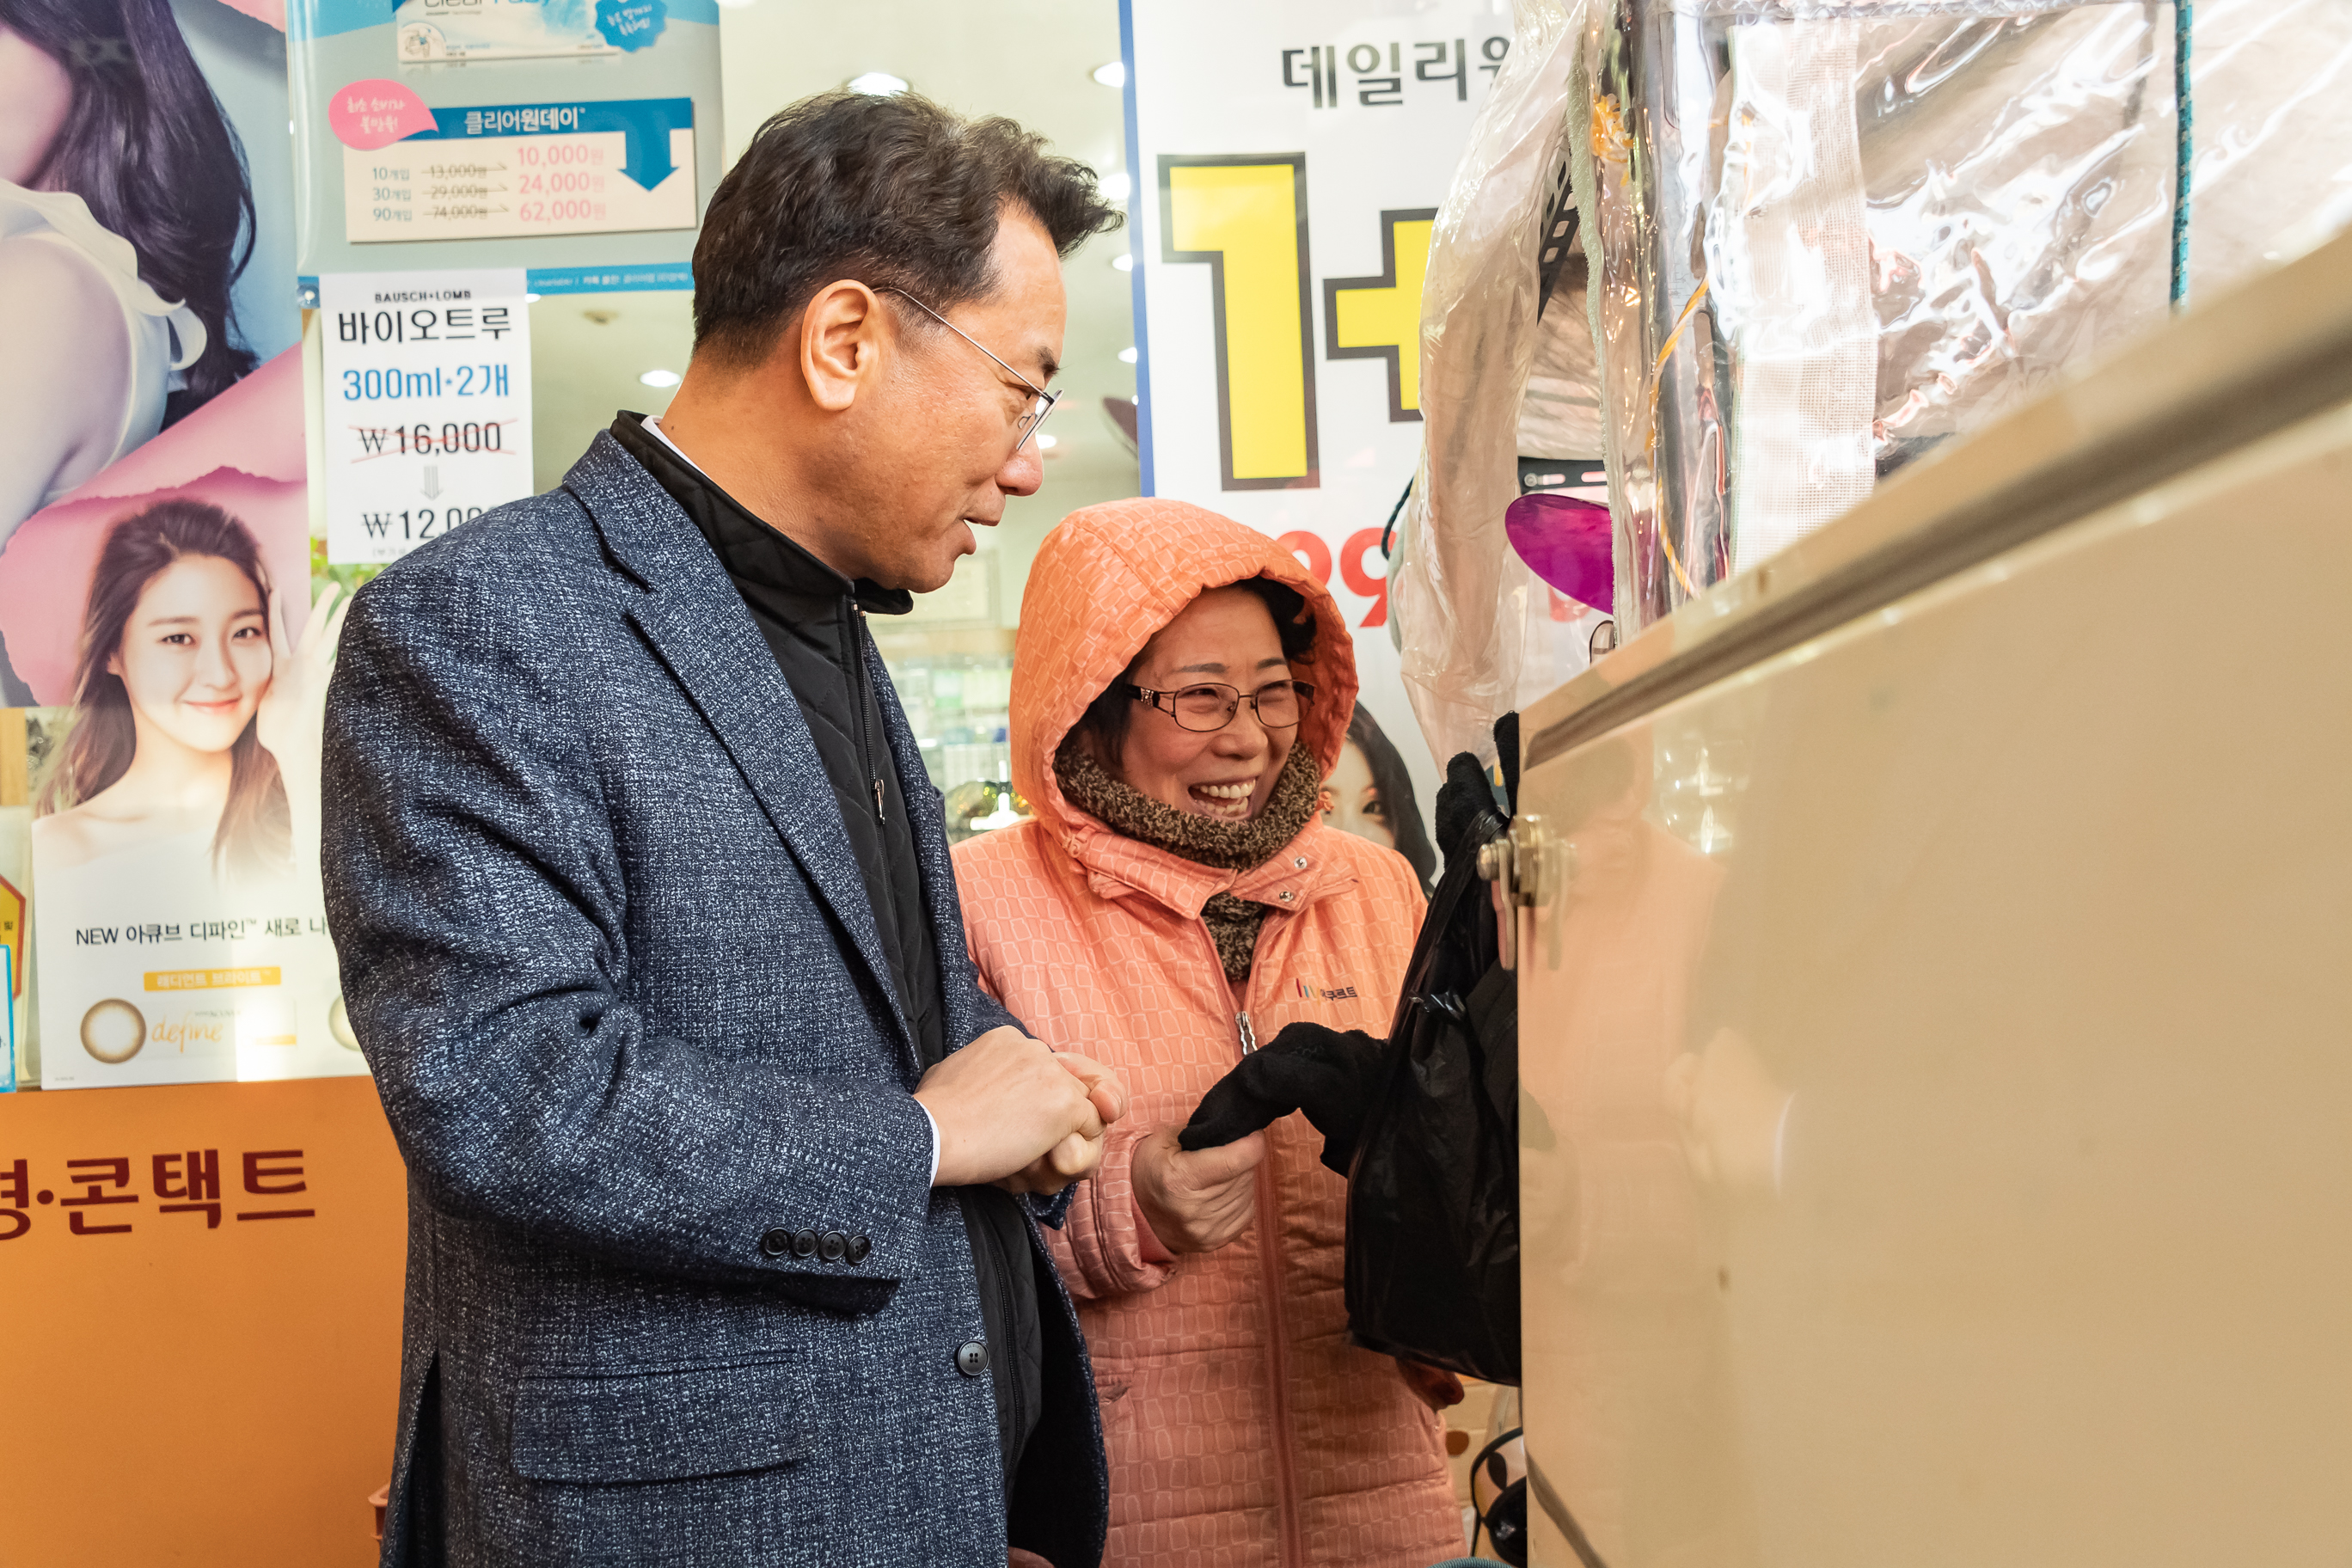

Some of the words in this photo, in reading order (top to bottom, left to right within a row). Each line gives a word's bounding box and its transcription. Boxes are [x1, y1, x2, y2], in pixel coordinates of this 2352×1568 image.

[517, 144, 604, 170] 10,000원
[518, 171, 605, 196] 24,000원
[519, 199, 606, 224] 62,000원
[338, 307, 511, 345] 바이오트루
[361, 505, 499, 542] ₩12,0
[76, 928, 119, 946] NEW
[126, 922, 183, 945] 아큐브
[264, 916, 303, 938] 새로
[151, 1008, 224, 1054] define
